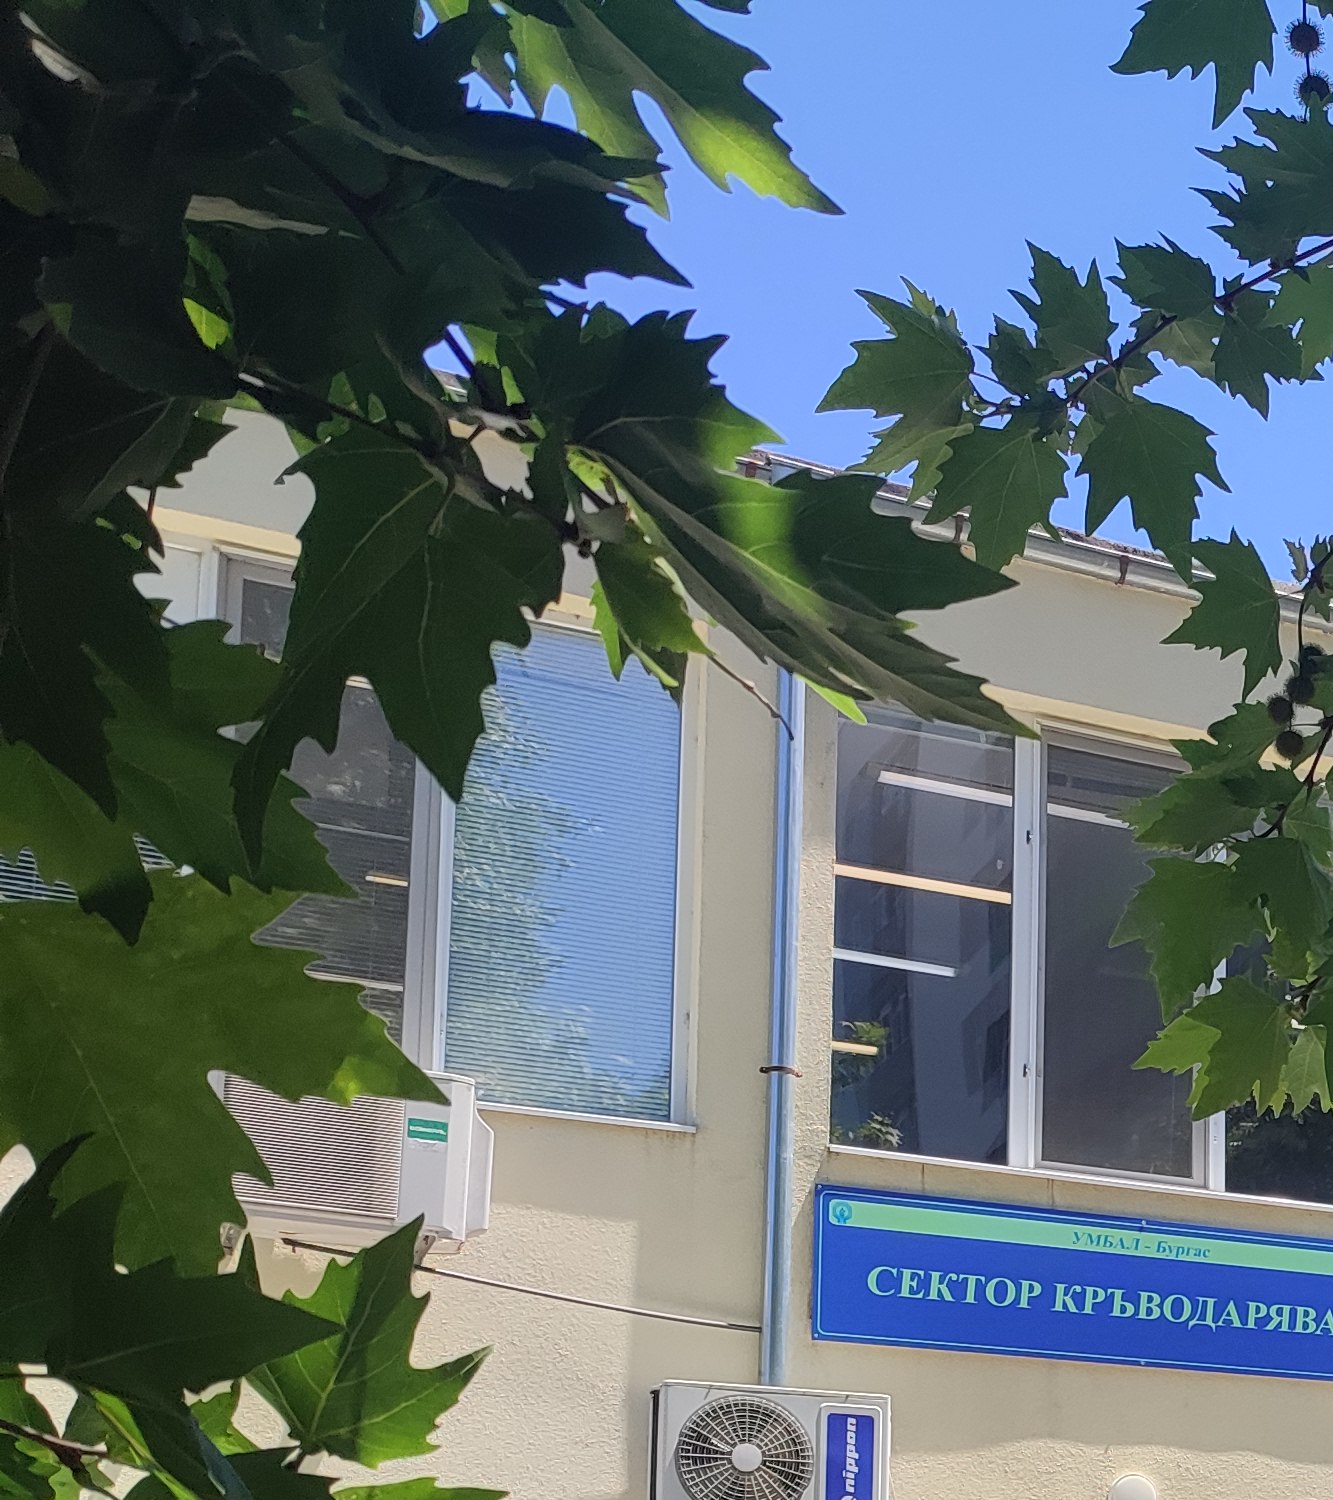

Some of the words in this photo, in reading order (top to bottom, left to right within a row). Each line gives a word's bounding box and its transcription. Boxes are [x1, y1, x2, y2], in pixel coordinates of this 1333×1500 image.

[1072, 1231, 1141, 1251] УМБАЛ
[1155, 1240, 1211, 1259] Бургас
[866, 1265, 1043, 1309] СЕКТОР
[842, 1416, 860, 1494] nippon
